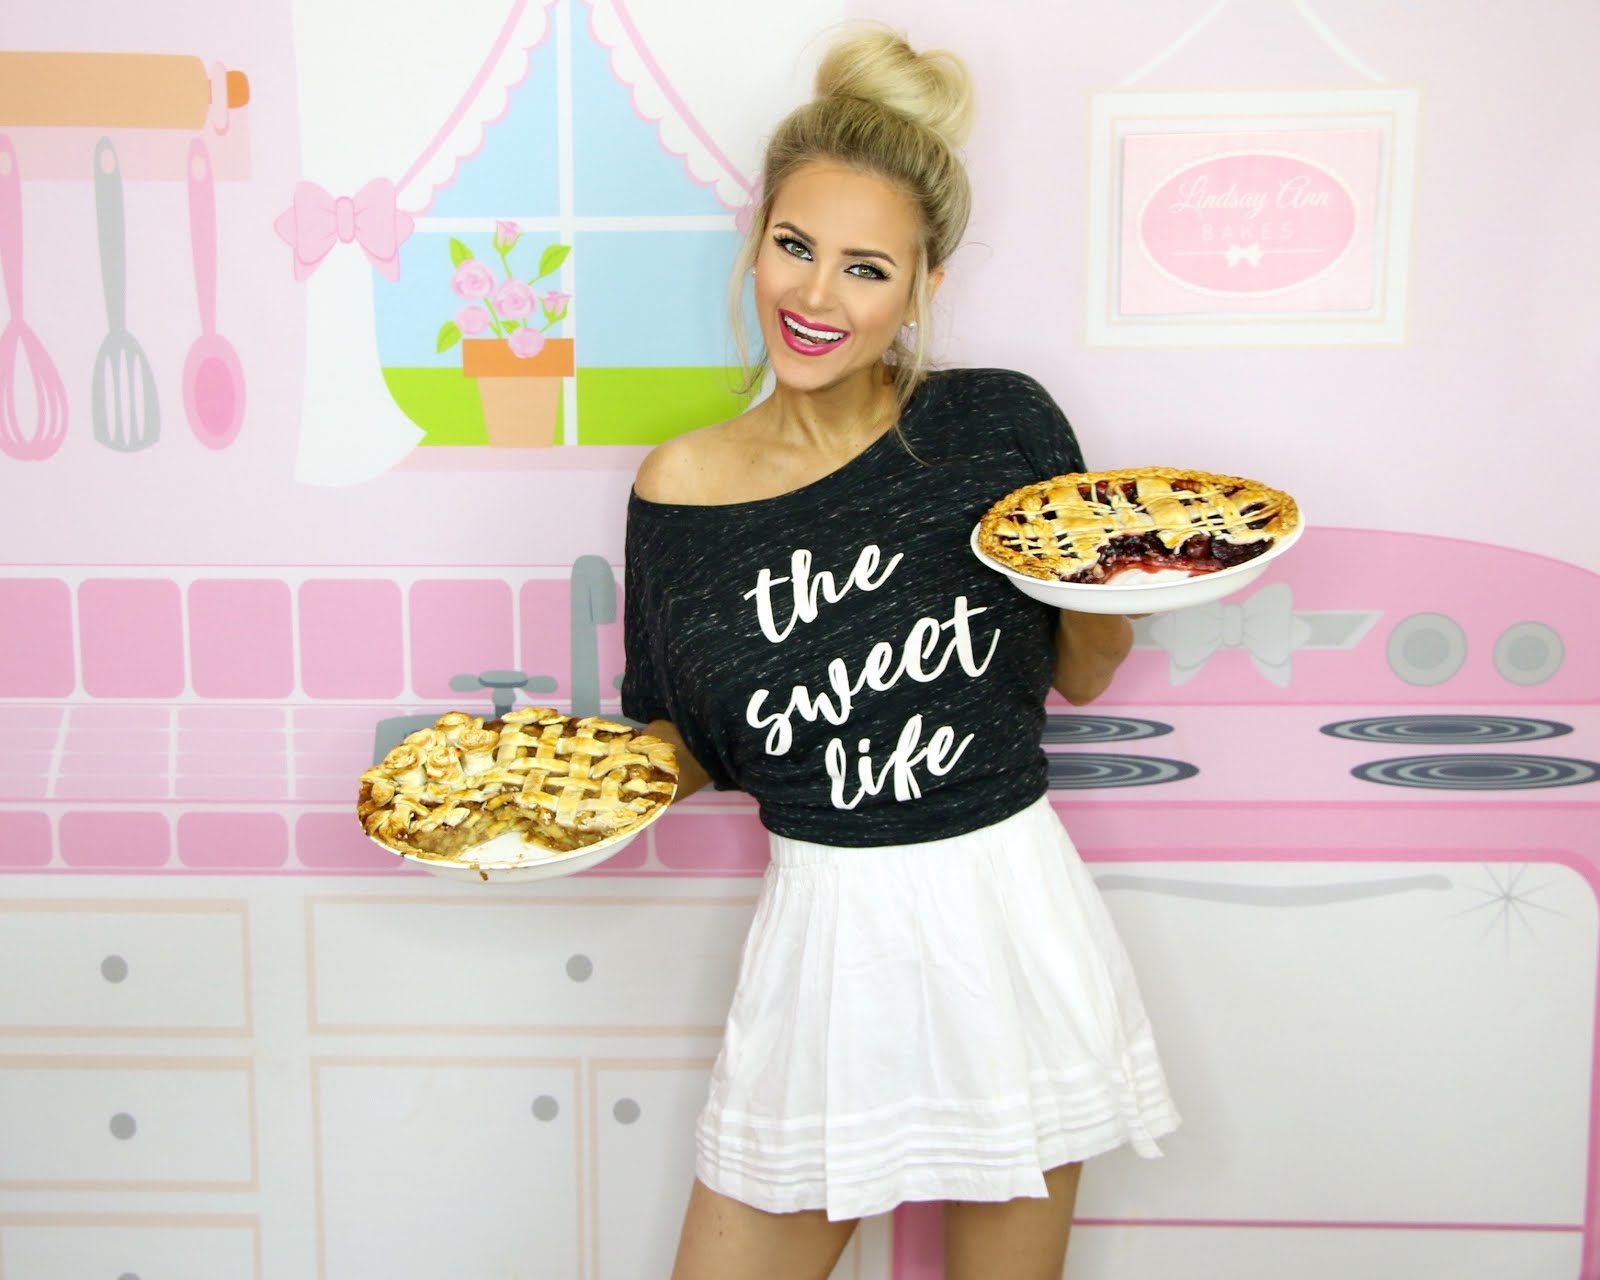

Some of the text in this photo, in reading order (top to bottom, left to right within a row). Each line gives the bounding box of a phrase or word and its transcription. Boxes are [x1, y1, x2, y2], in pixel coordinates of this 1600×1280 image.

[1168, 175, 1330, 219] Lindsay Ann
[1201, 221, 1296, 241] BAKES
[743, 544, 904, 643] the
[746, 596, 1000, 756] sweet
[825, 713, 974, 810] life
